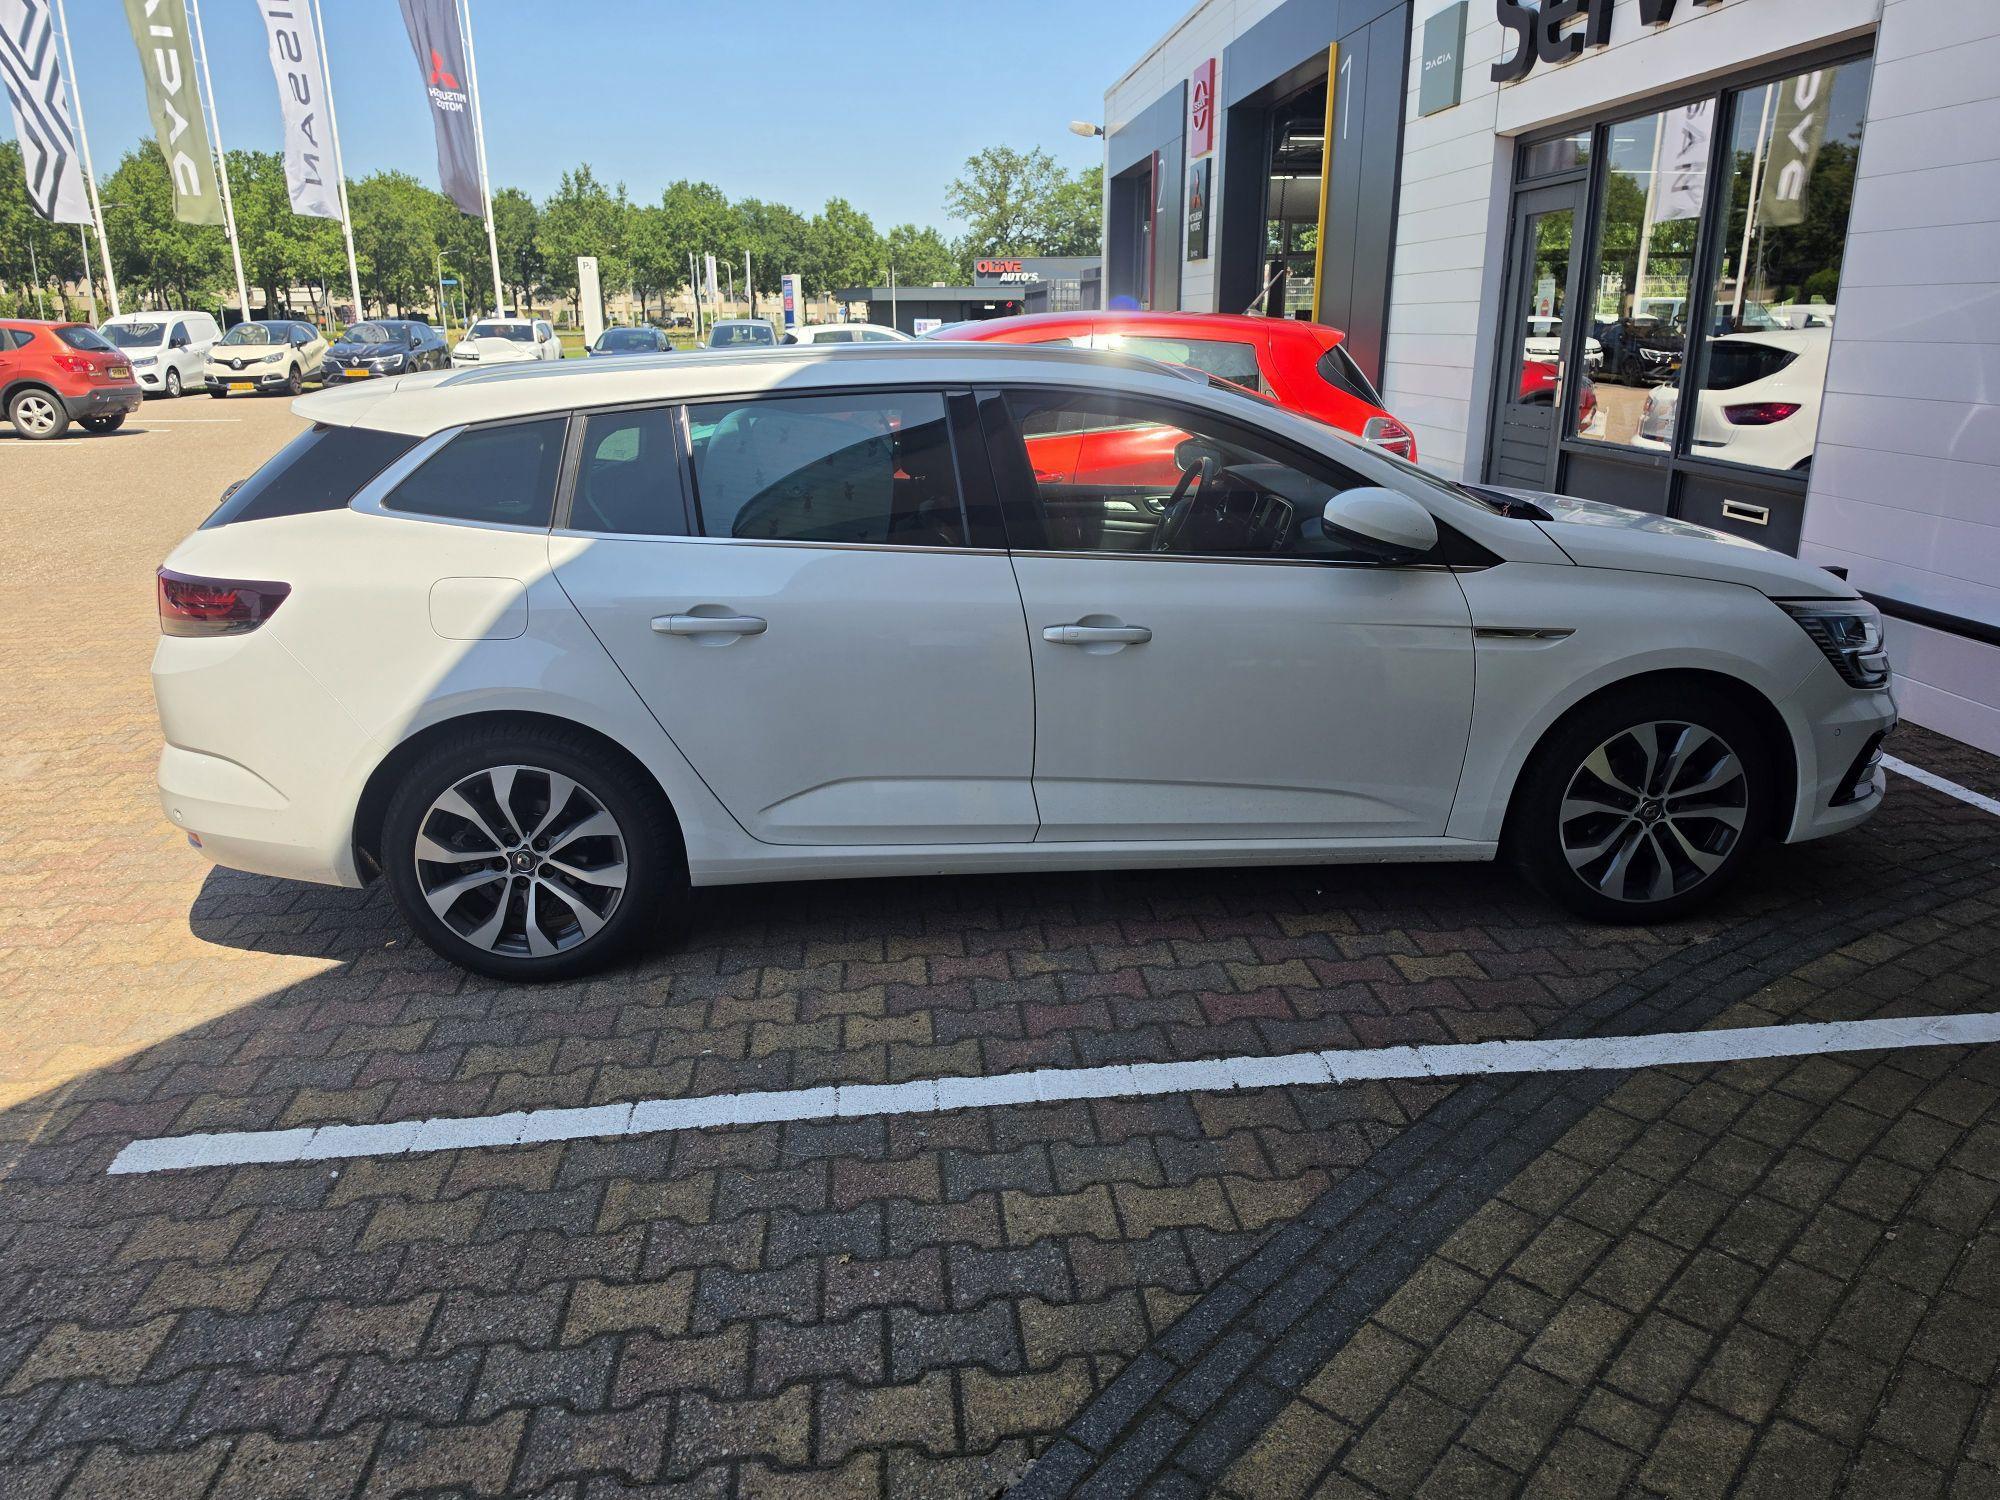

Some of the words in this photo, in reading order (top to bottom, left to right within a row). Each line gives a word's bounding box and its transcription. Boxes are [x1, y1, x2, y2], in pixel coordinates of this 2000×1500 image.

[1425, 52, 1452, 71] DACIA
[1341, 54, 1352, 140] 1
[1157, 158, 1166, 213] 2
[1000, 272, 1039, 282] AUTO'S
